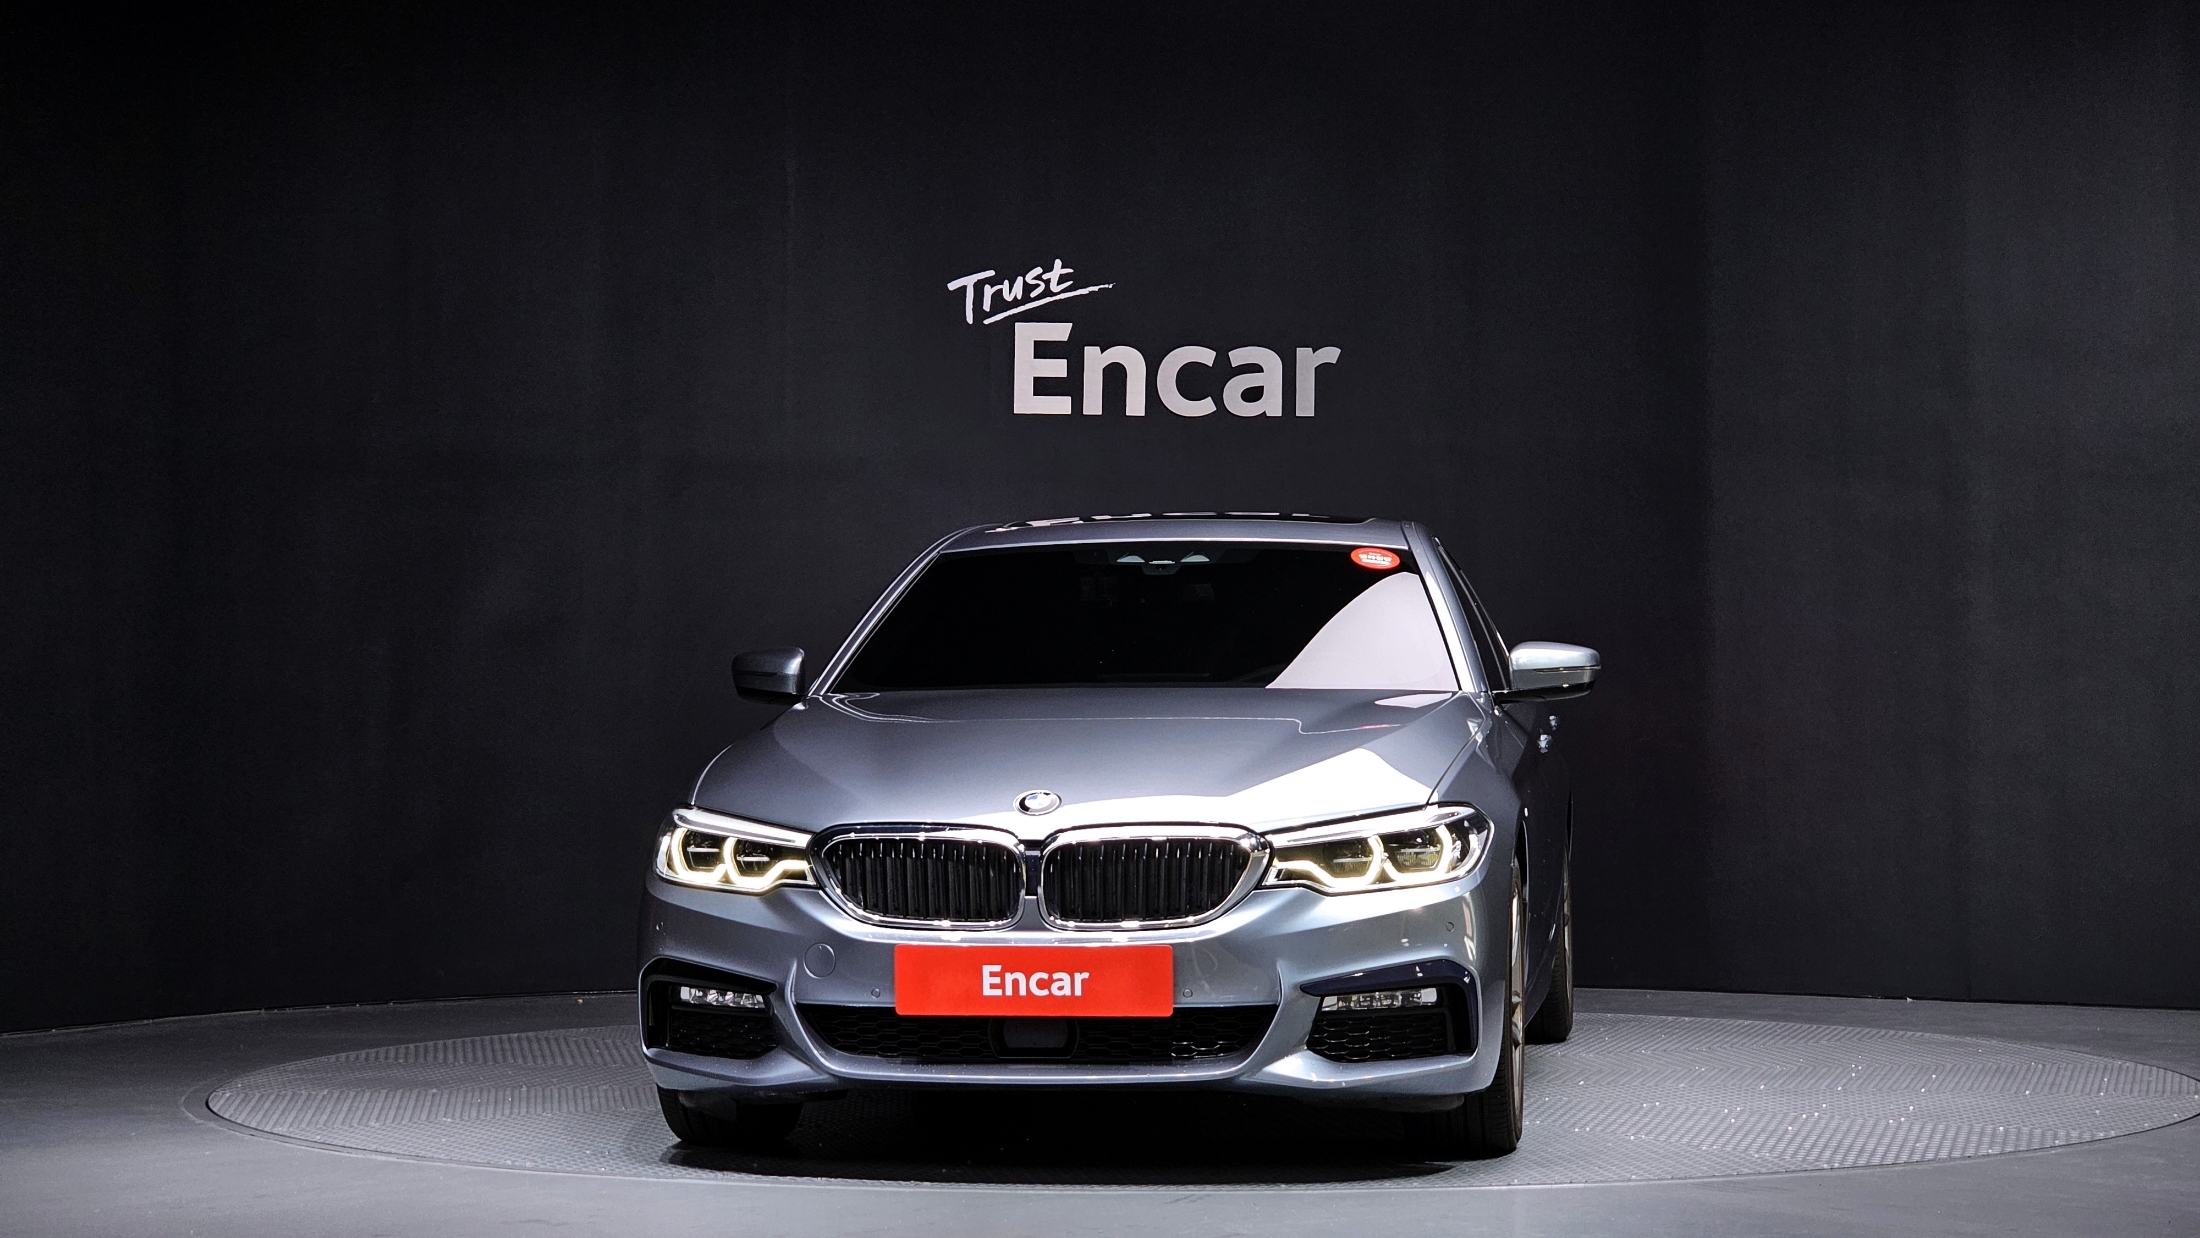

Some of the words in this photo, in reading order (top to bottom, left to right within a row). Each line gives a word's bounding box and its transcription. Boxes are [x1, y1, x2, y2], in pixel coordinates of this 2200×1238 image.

[947, 259, 1074, 324] Trust
[1014, 322, 1342, 417] Encar
[982, 964, 1090, 996] Encar
